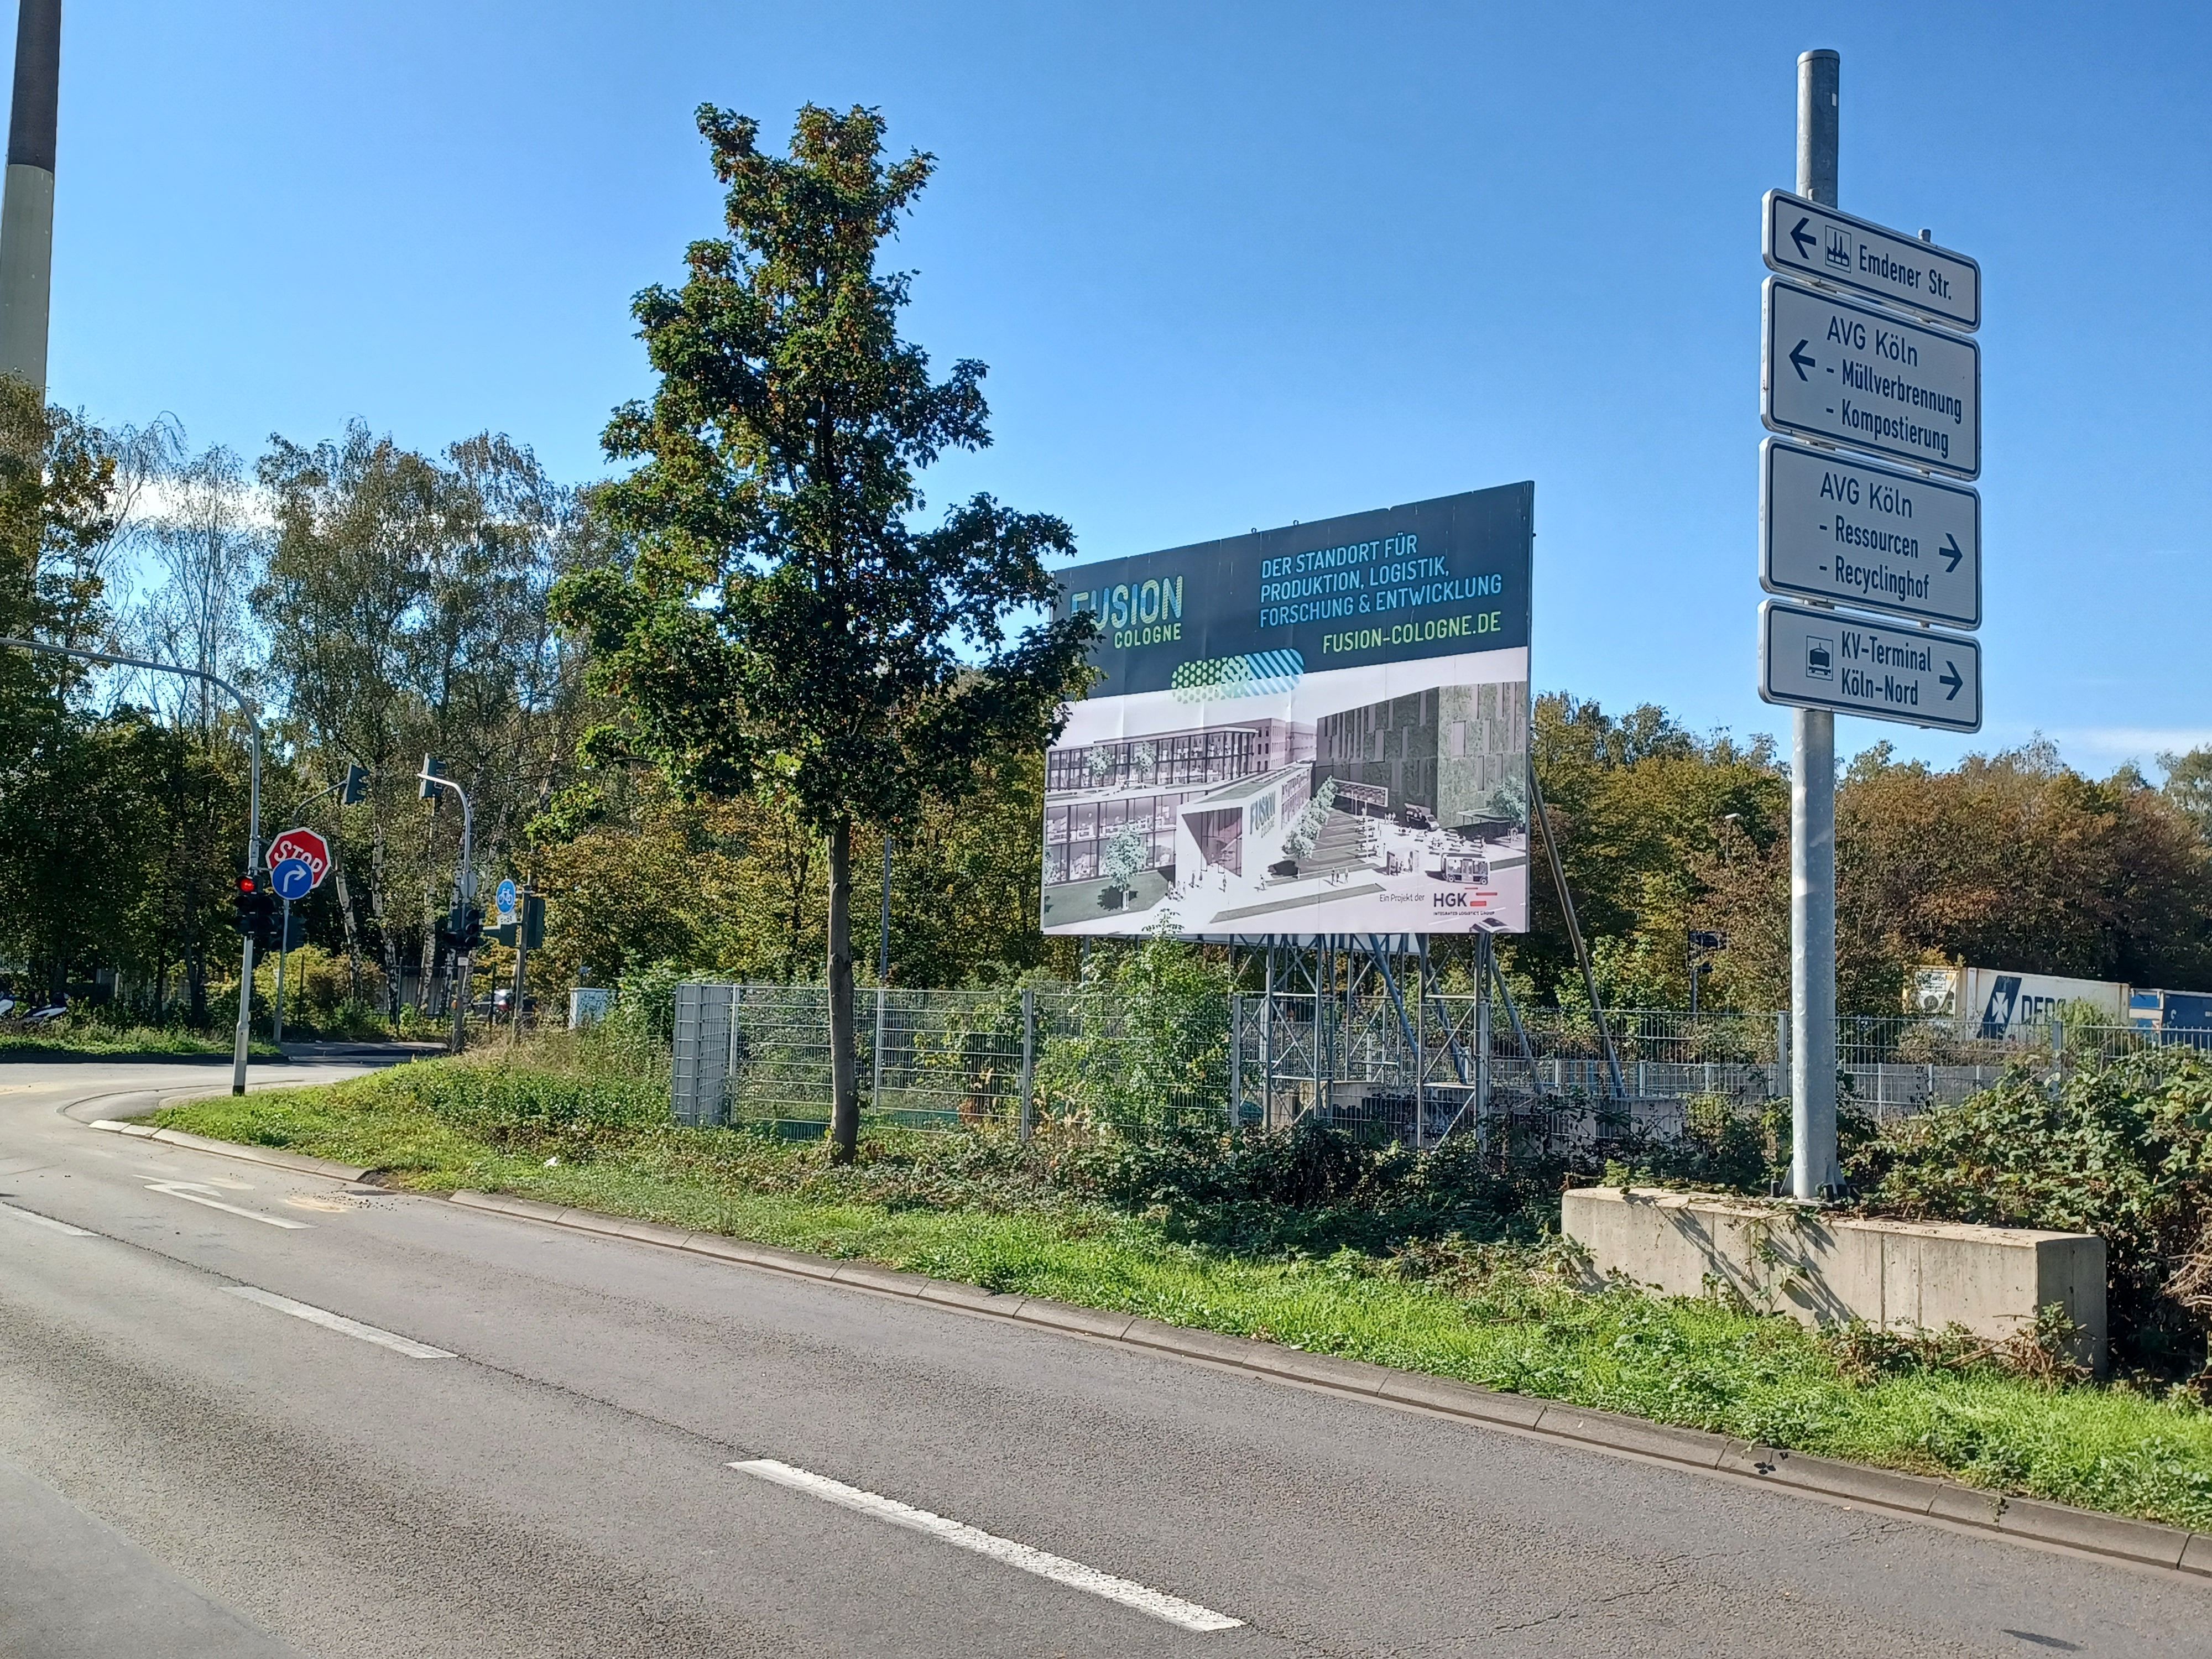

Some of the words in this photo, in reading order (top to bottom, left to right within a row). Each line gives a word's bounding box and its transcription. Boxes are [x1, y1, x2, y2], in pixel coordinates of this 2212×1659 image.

[1859, 245, 1921, 289] Emdener
[1928, 269, 1952, 300] Str.
[1827, 316, 1866, 350] AVG
[1876, 329, 1917, 367] Köln
[1842, 359, 1961, 424] Müllverbrennung
[1841, 399, 1949, 459] Kompostierung
[1820, 472, 1859, 505] AVG
[1870, 482, 1912, 518] Köln
[1261, 556, 1292, 578] DER
[1296, 541, 1380, 573] STANDORT
[1385, 533, 1417, 558] FÜR
[1836, 514, 1918, 559] Ressourcen
[1260, 571, 1364, 603] PRODUKTION,
[1370, 555, 1449, 587] LOGISTIK,
[1260, 597, 1353, 628] FORSCHUNG
[1359, 594, 1370, 613] &
[1376, 573, 1502, 611] ENTWICKLUNG
[1836, 555, 1929, 601] Recyclinghof
[1114, 623, 1181, 649] COLOGNE
[1323, 611, 1501, 654] FUSION-COLOGNE.DE
[1841, 630, 1932, 672] KV-Terminal
[1841, 667, 1918, 706] Köln-Nord
[1391, 893, 1412, 903] Projekt
[1433, 893, 1467, 907] HGK
